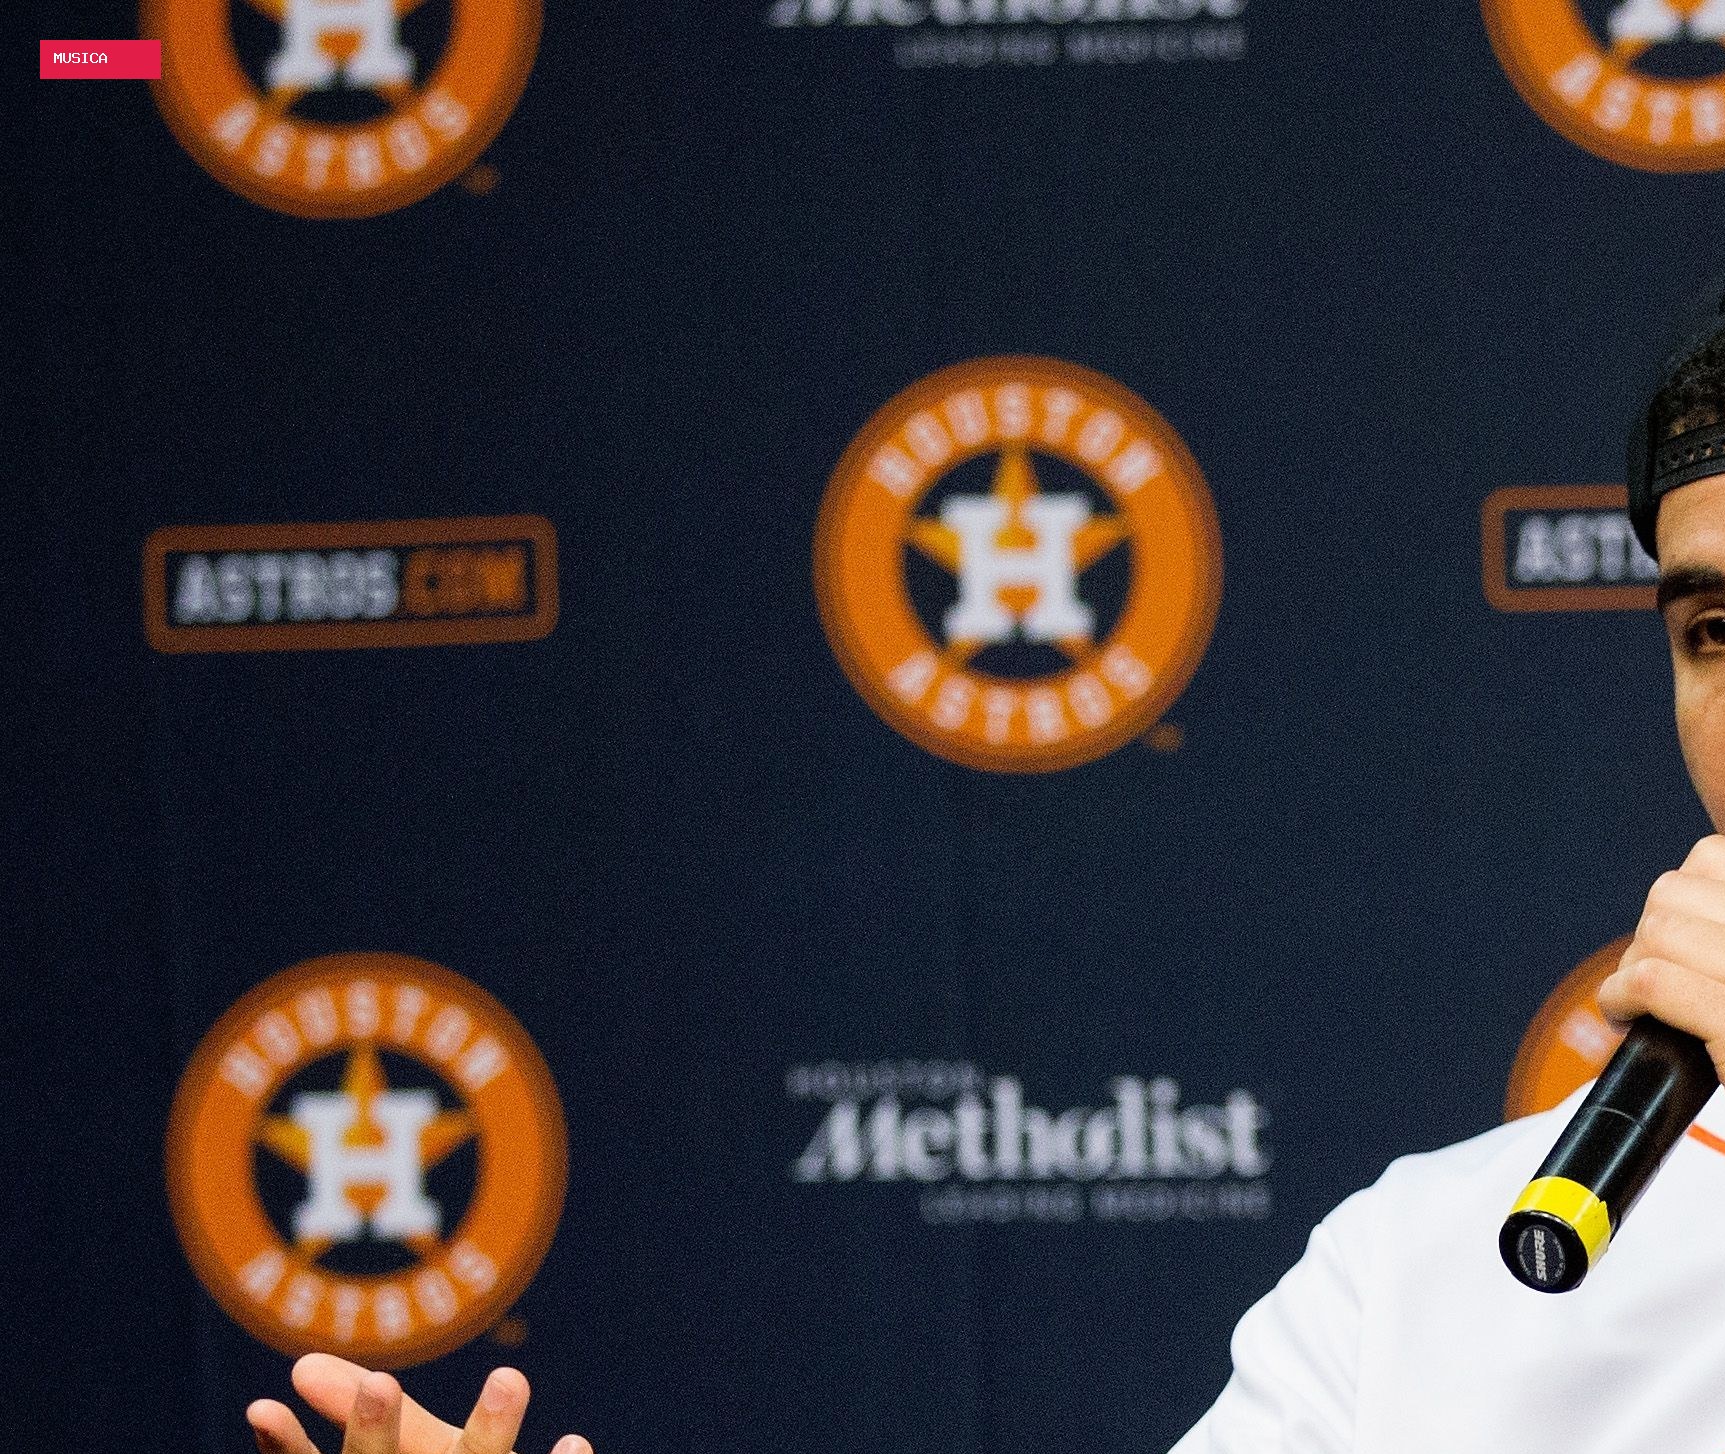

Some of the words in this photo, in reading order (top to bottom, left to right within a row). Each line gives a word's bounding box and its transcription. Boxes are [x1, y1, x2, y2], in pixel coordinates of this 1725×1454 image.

[212, 90, 470, 191] ASTROS
[866, 382, 1166, 499] HOUSTON
[941, 492, 1095, 643] H
[887, 644, 1155, 744] ASTROS
[218, 980, 510, 1096] HOUSTON
[292, 1089, 443, 1241] H
[794, 1073, 1273, 1182] Methodist
[240, 1240, 499, 1343] ASTROS
[1534, 1229, 1547, 1281] SHURE
